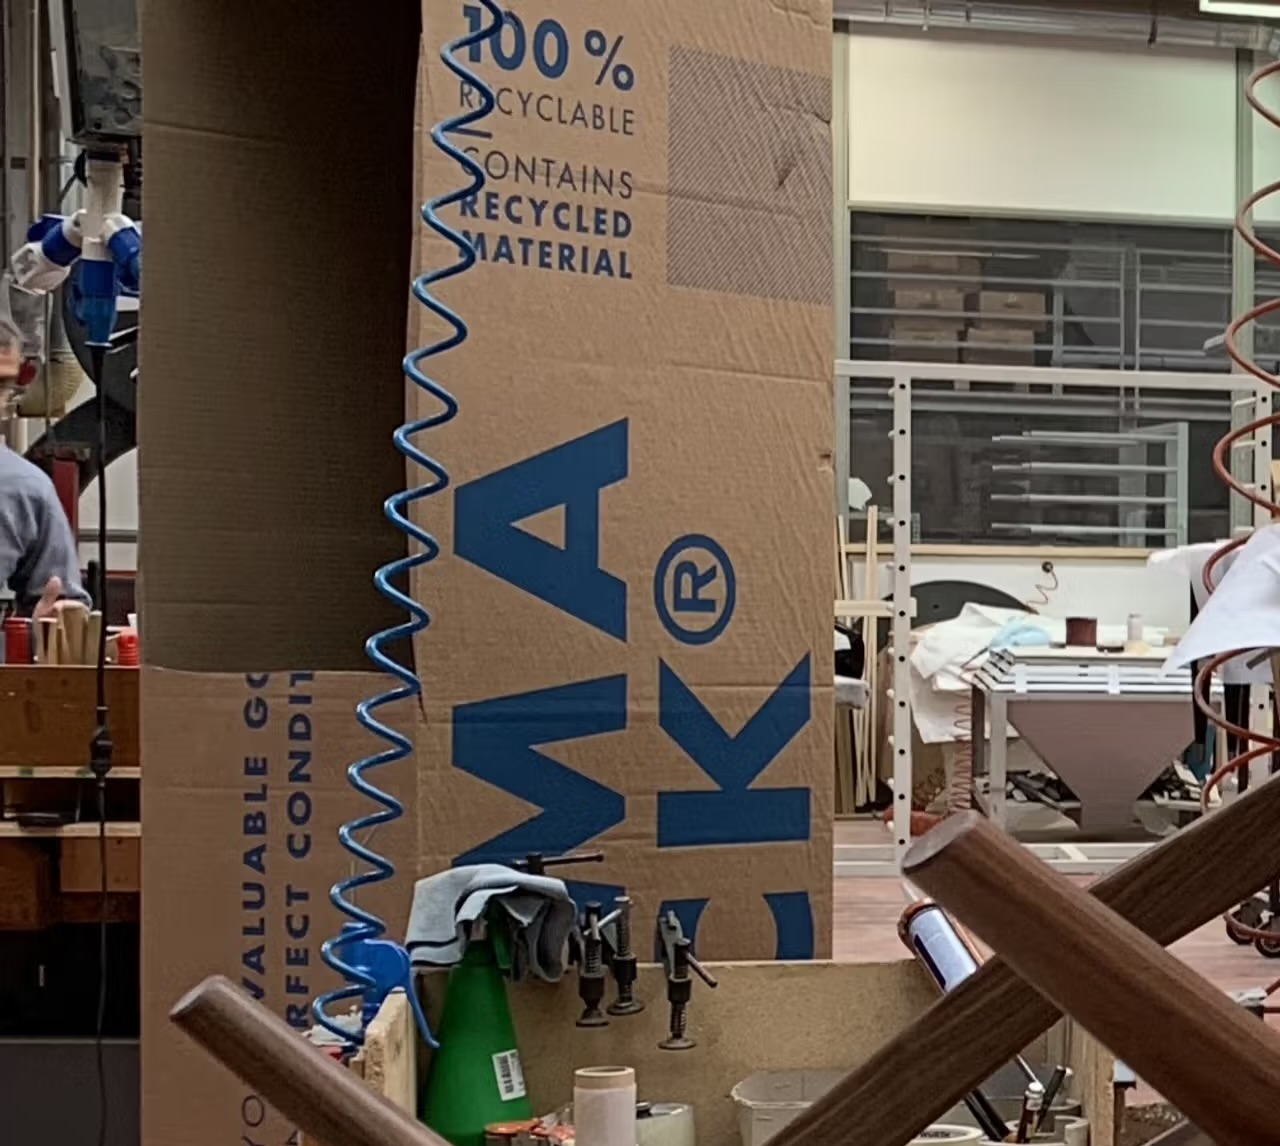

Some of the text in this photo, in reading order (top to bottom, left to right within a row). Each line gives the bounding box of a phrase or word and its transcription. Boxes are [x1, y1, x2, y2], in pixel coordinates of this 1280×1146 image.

[458, 191, 633, 239] RECYCLED
[458, 231, 633, 280] MATERIAL
[285, 883, 310, 1029] RFECT
